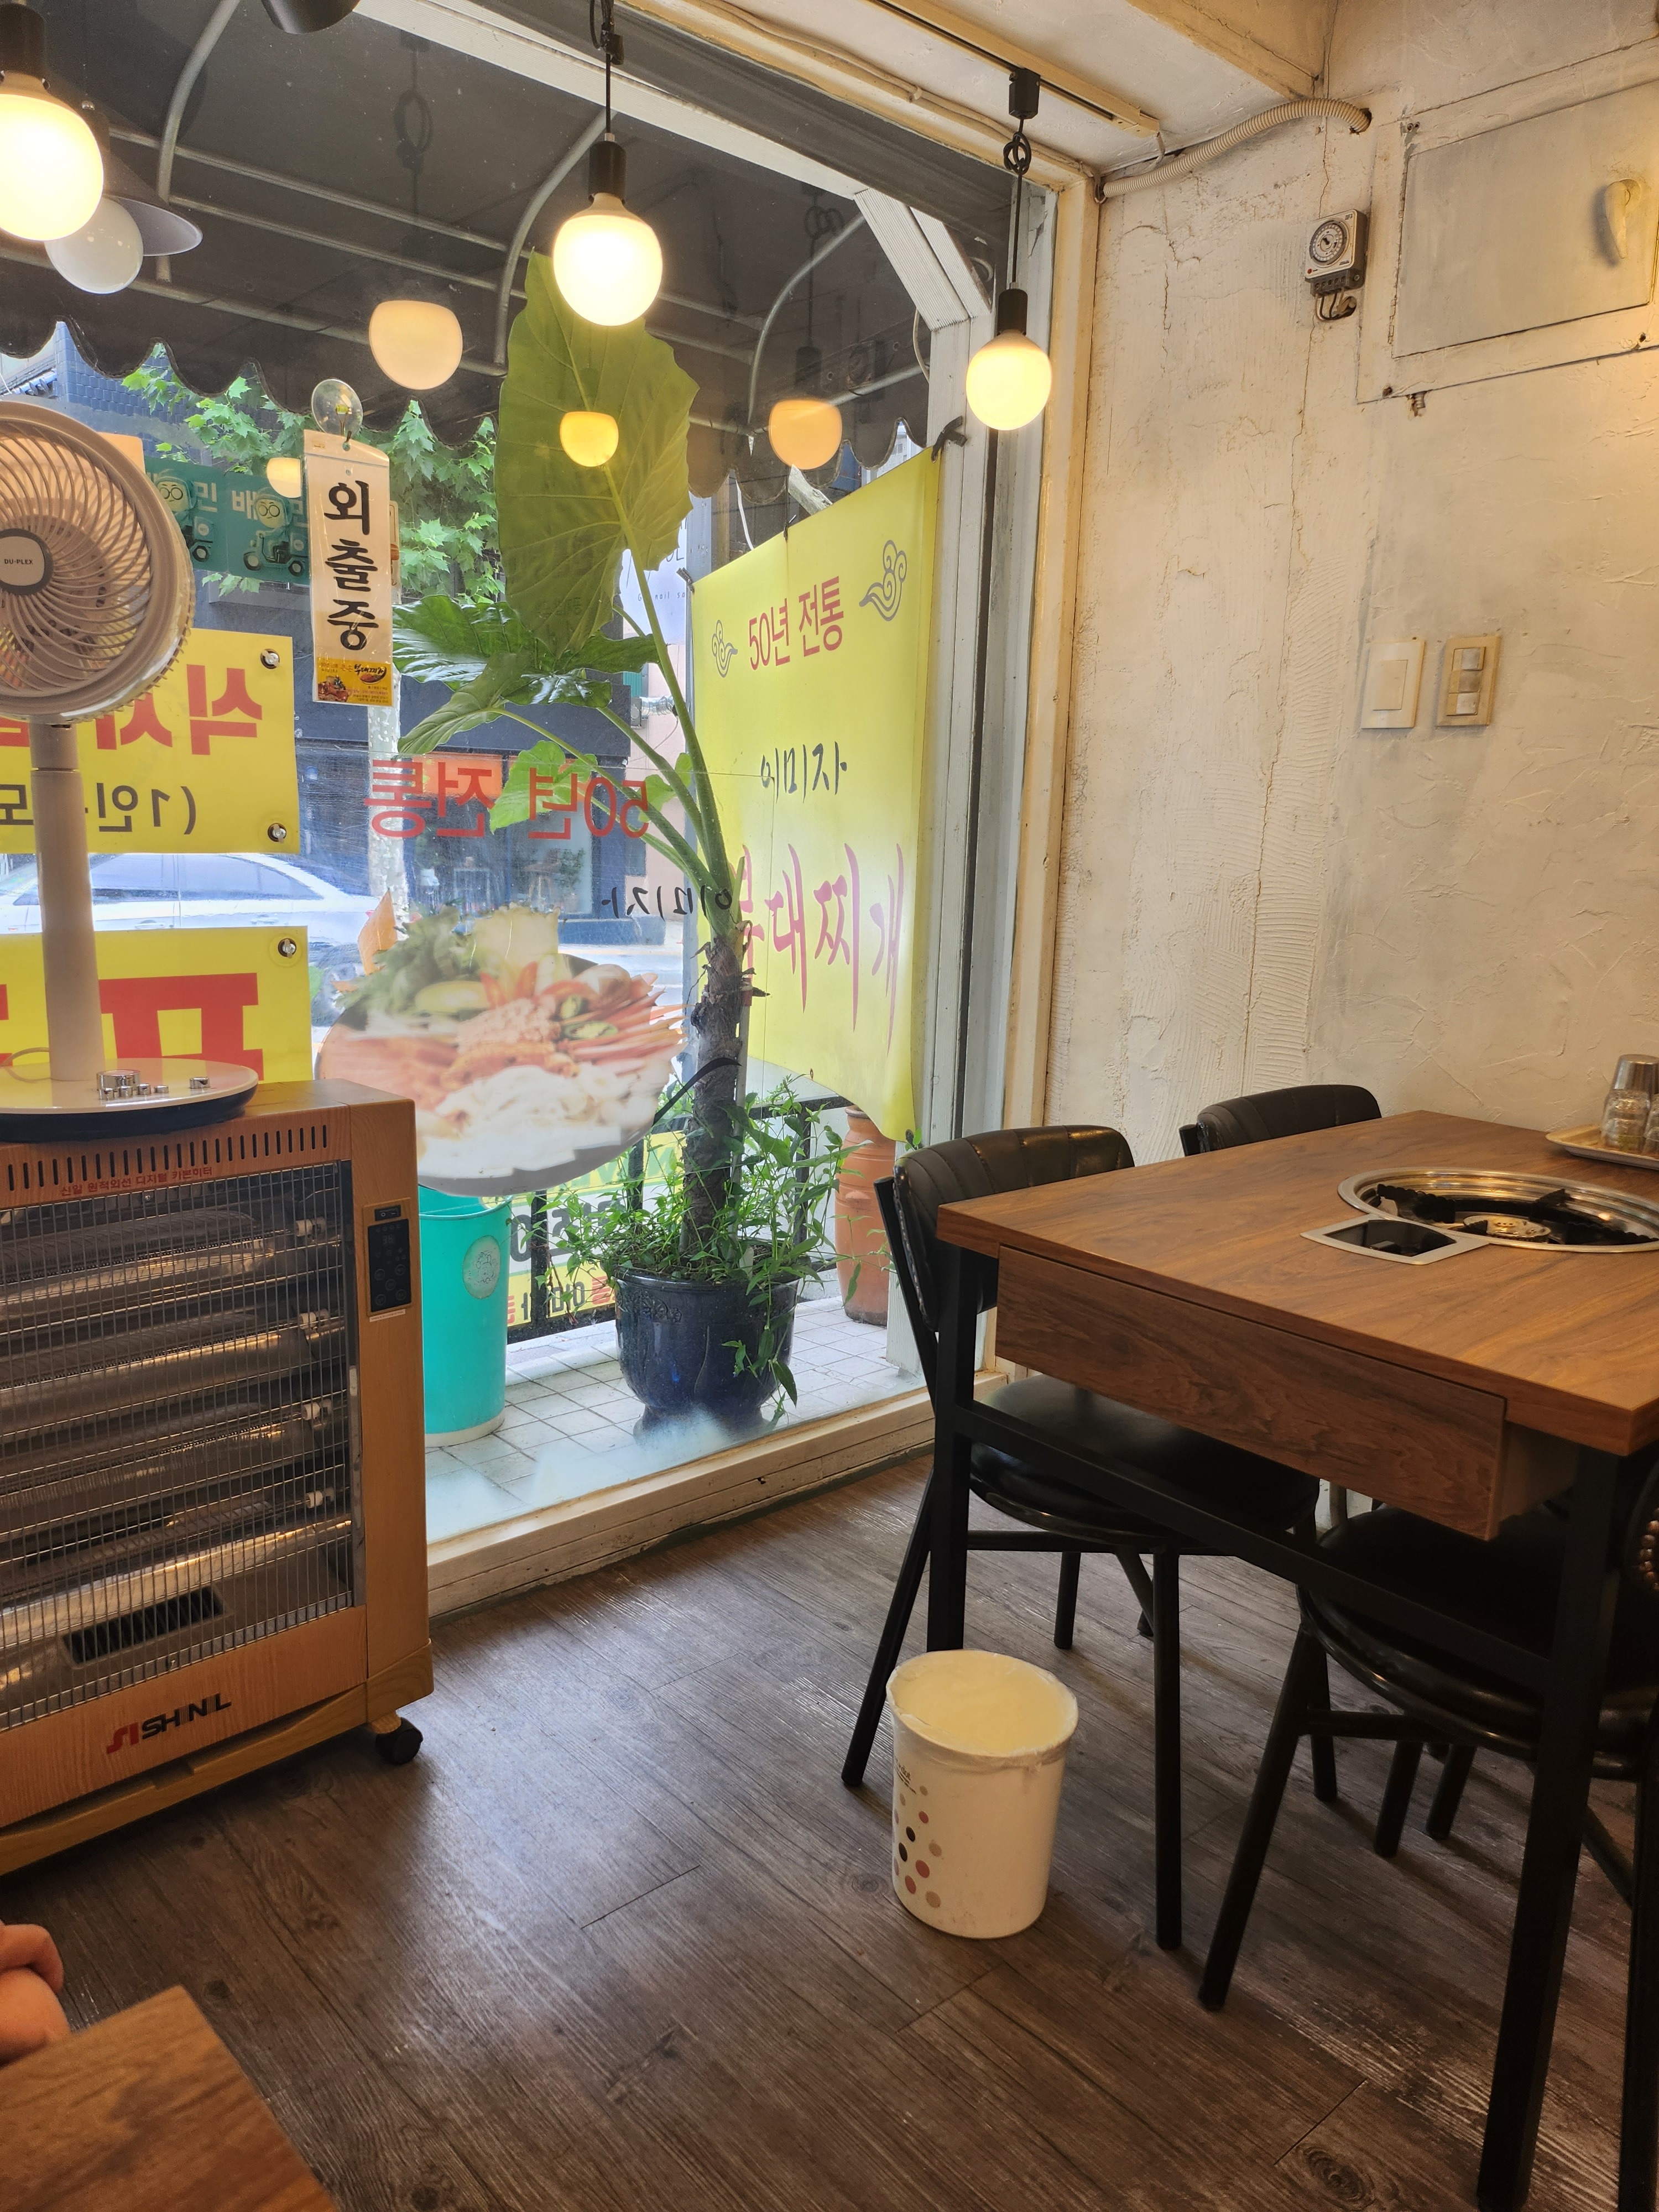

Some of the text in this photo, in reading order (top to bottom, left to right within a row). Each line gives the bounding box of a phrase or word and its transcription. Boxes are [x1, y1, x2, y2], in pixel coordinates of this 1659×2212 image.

[324, 479, 379, 651] 외출중
[655, 591, 670, 600] nail
[749, 576, 844, 671] 50년 전통
[760, 741, 848, 804] 이미자
[61, 1184, 83, 1197] 신일
[135, 1172, 168, 1185] 디지털
